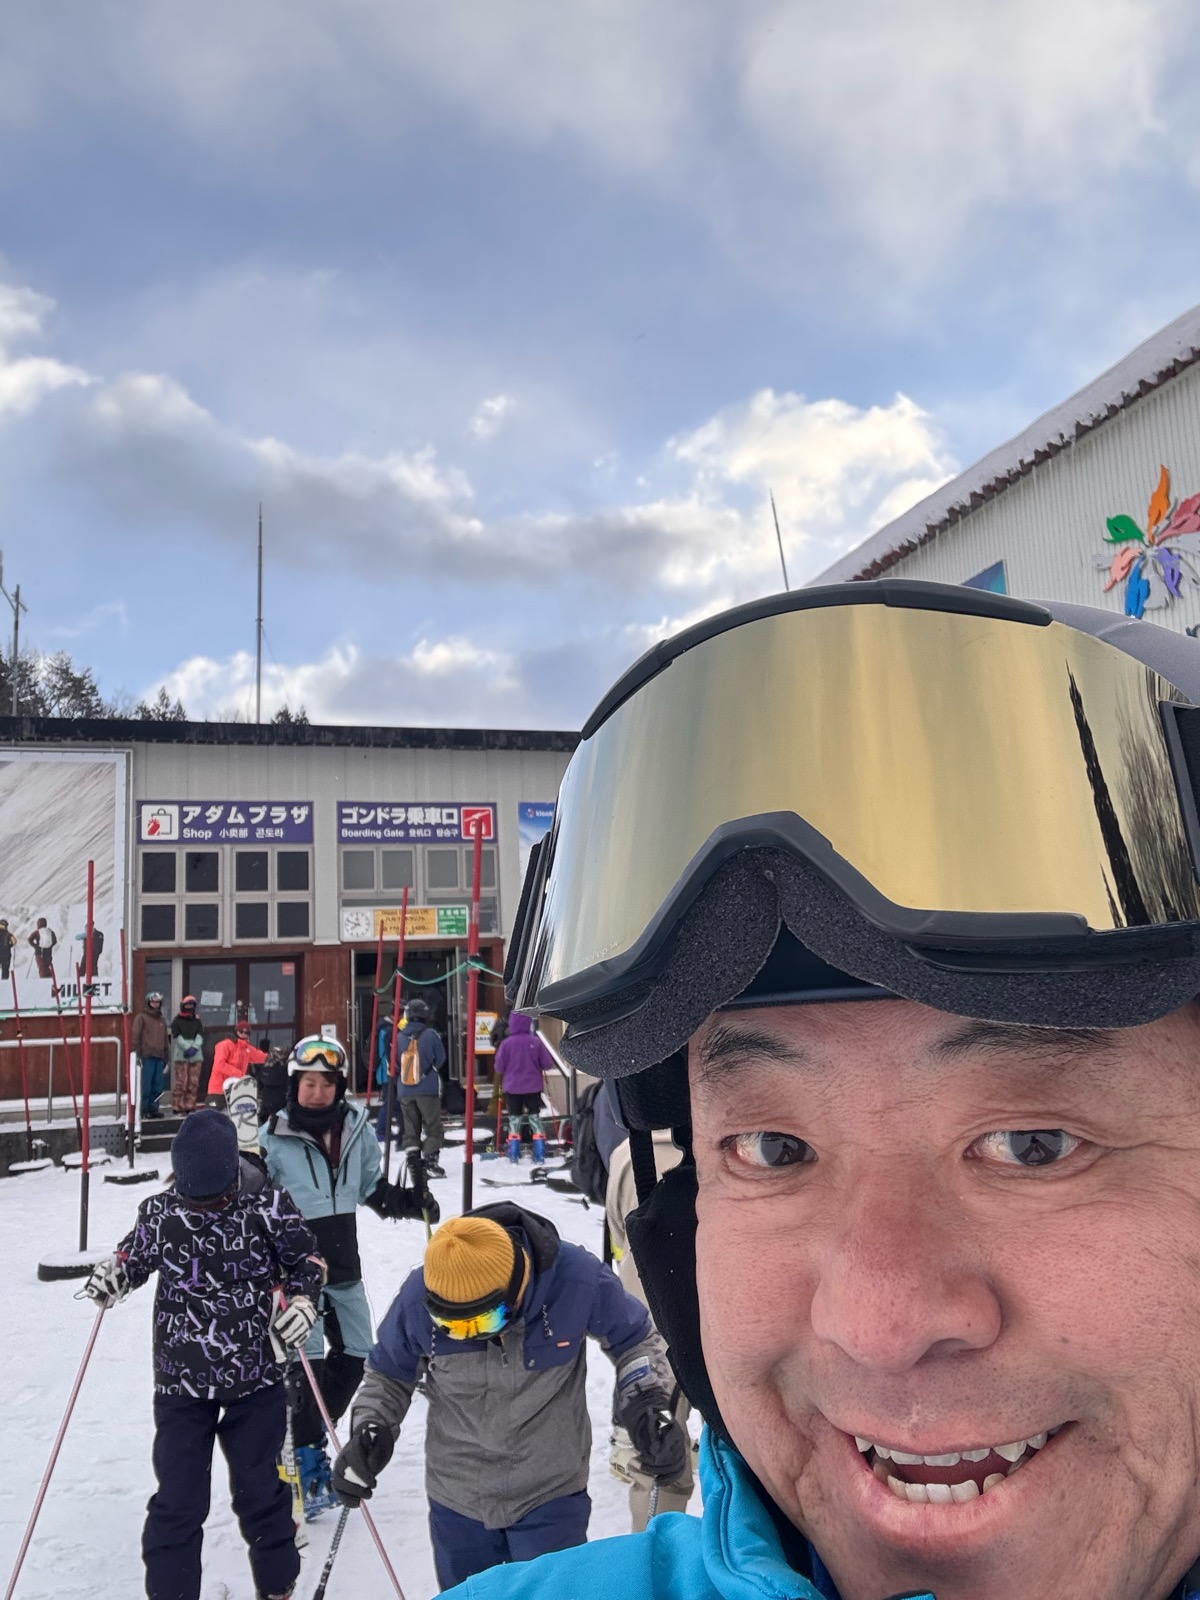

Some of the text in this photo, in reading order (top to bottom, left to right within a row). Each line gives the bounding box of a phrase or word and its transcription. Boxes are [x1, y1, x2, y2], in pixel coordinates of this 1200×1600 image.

[182, 805, 309, 824] アダムプラザ
[341, 806, 459, 825] ゴンドラ乗車口
[183, 827, 212, 840] Shop
[341, 828, 381, 839] Boarding
[383, 828, 404, 838] Gate
